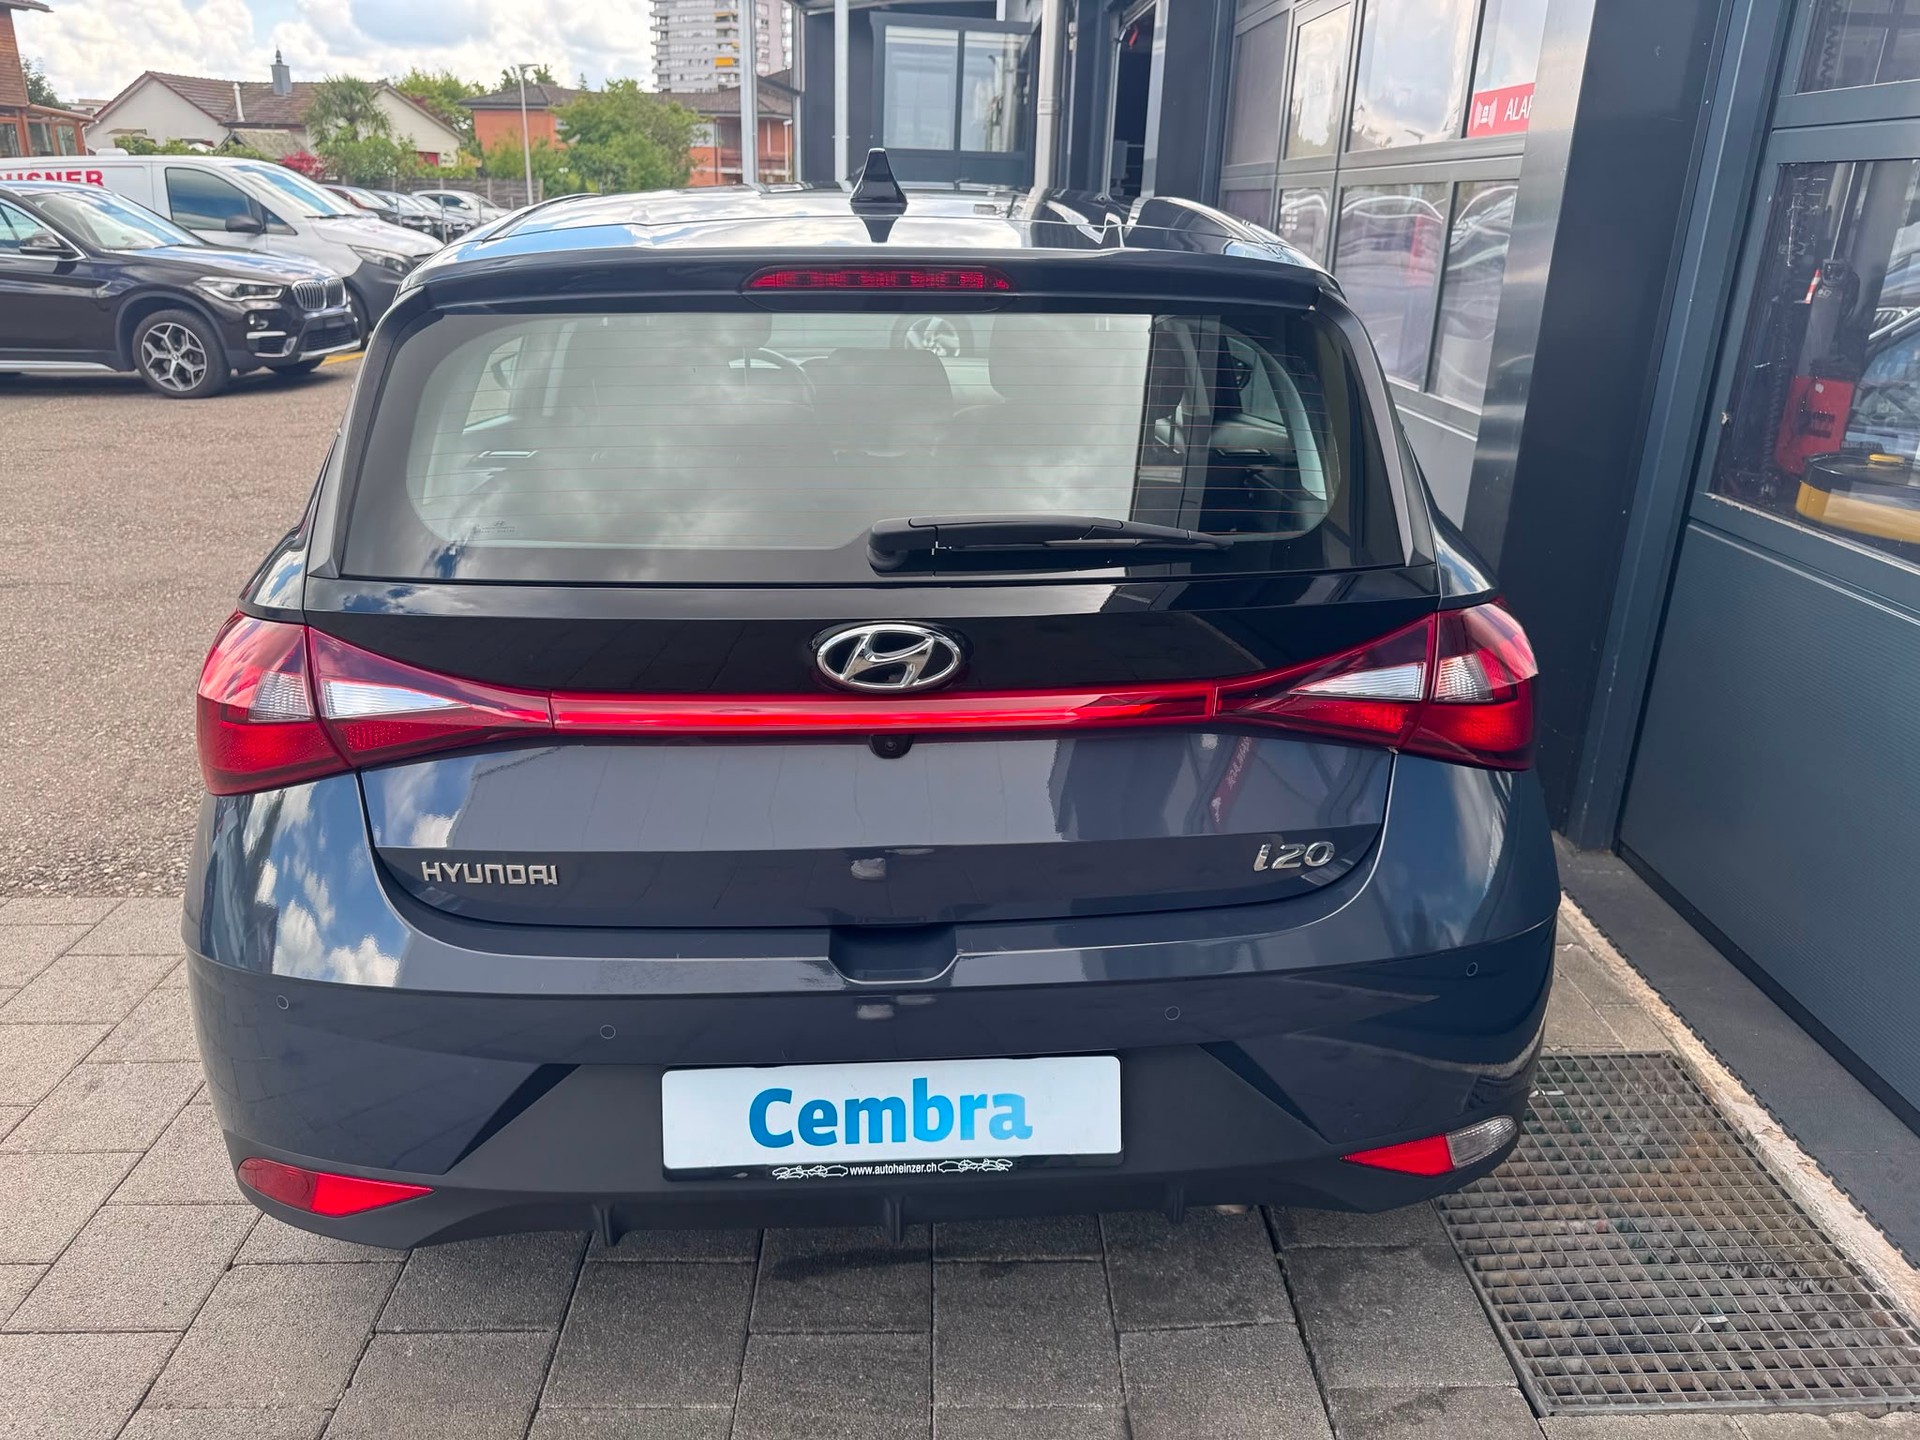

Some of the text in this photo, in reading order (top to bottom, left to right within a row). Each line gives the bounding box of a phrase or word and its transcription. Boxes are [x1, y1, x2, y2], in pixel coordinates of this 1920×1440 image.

[0, 170, 104, 187] NER
[1253, 841, 1335, 871] i20
[421, 861, 558, 885] HYUNDAI
[748, 1077, 1033, 1149] Cembra
[850, 1162, 937, 1176] www.autoheinzer.ch
